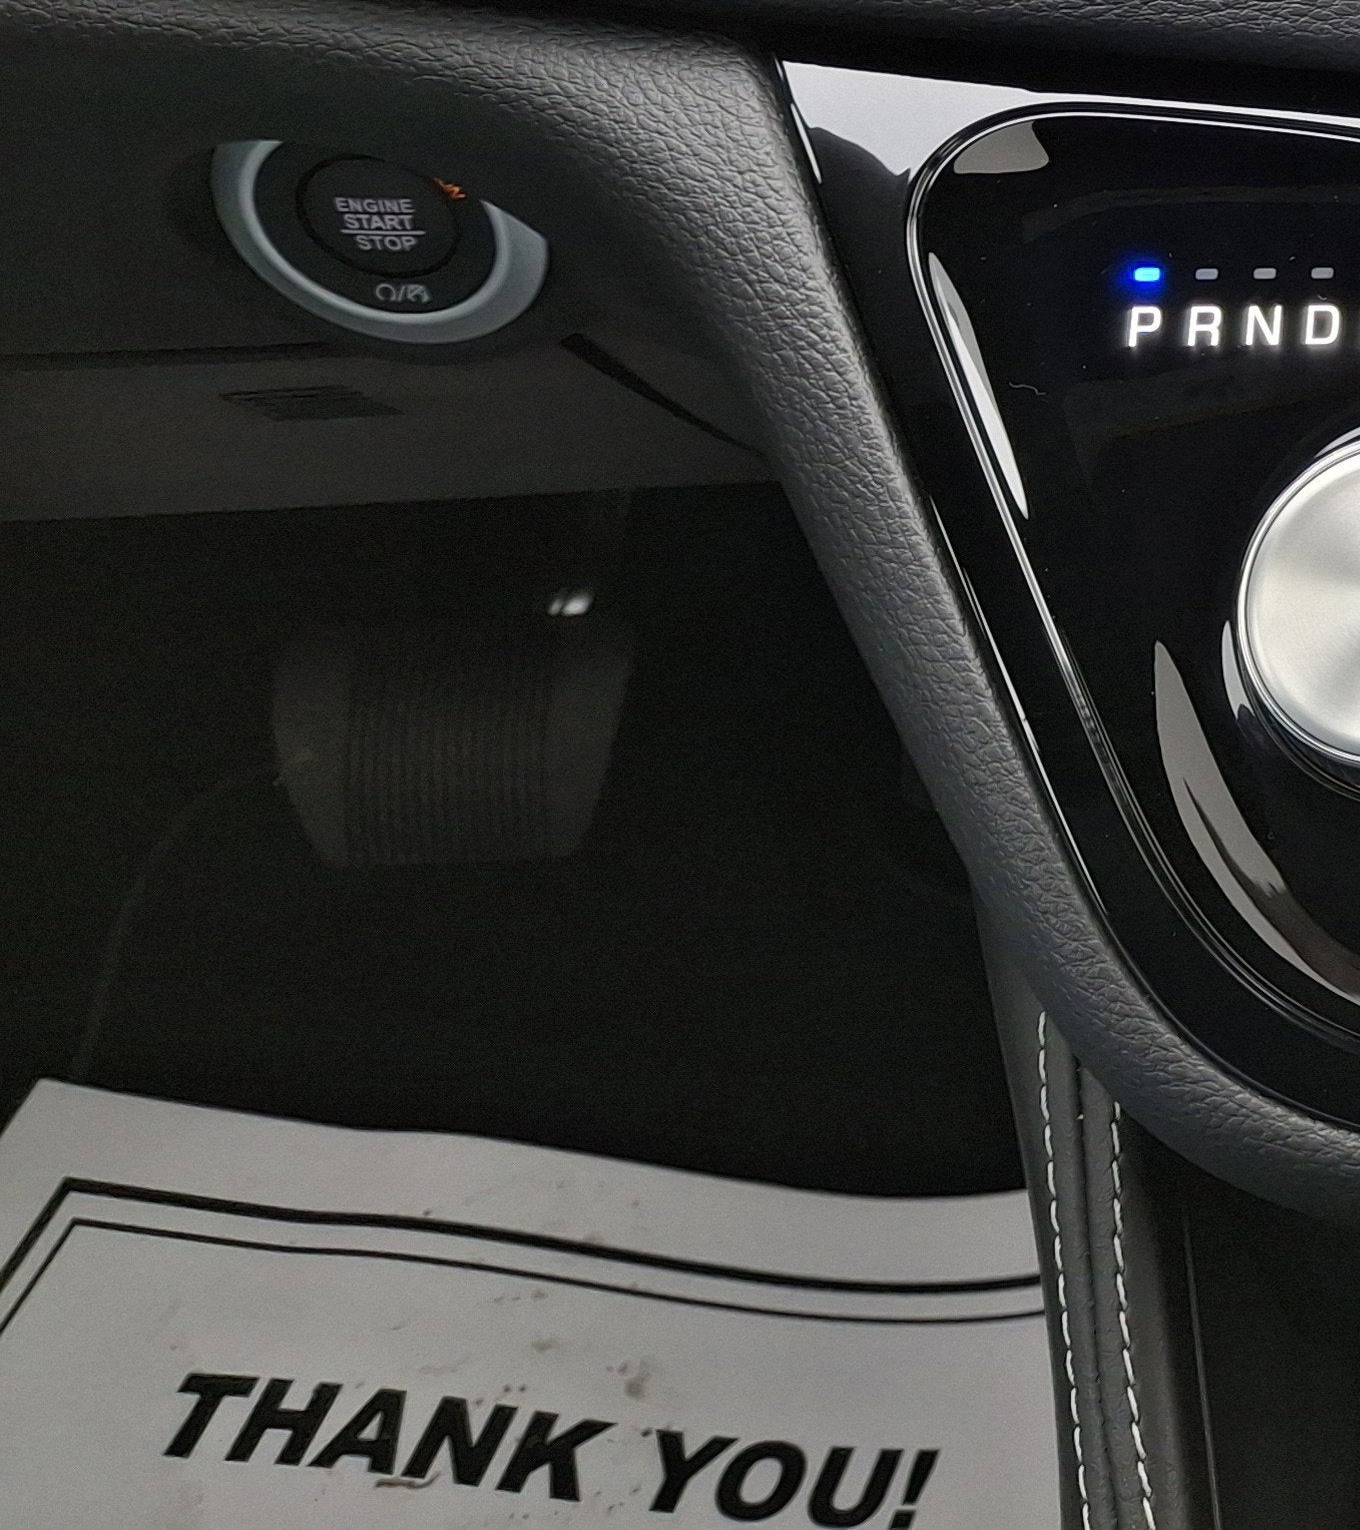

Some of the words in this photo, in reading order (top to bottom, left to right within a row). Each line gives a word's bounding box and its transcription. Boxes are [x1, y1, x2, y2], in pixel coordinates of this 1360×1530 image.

[334, 197, 414, 213] ENGINE
[343, 214, 413, 229] START
[356, 235, 418, 251] STOP
[162, 1372, 617, 1503] THANK
[648, 1429, 940, 1530] YOU!
